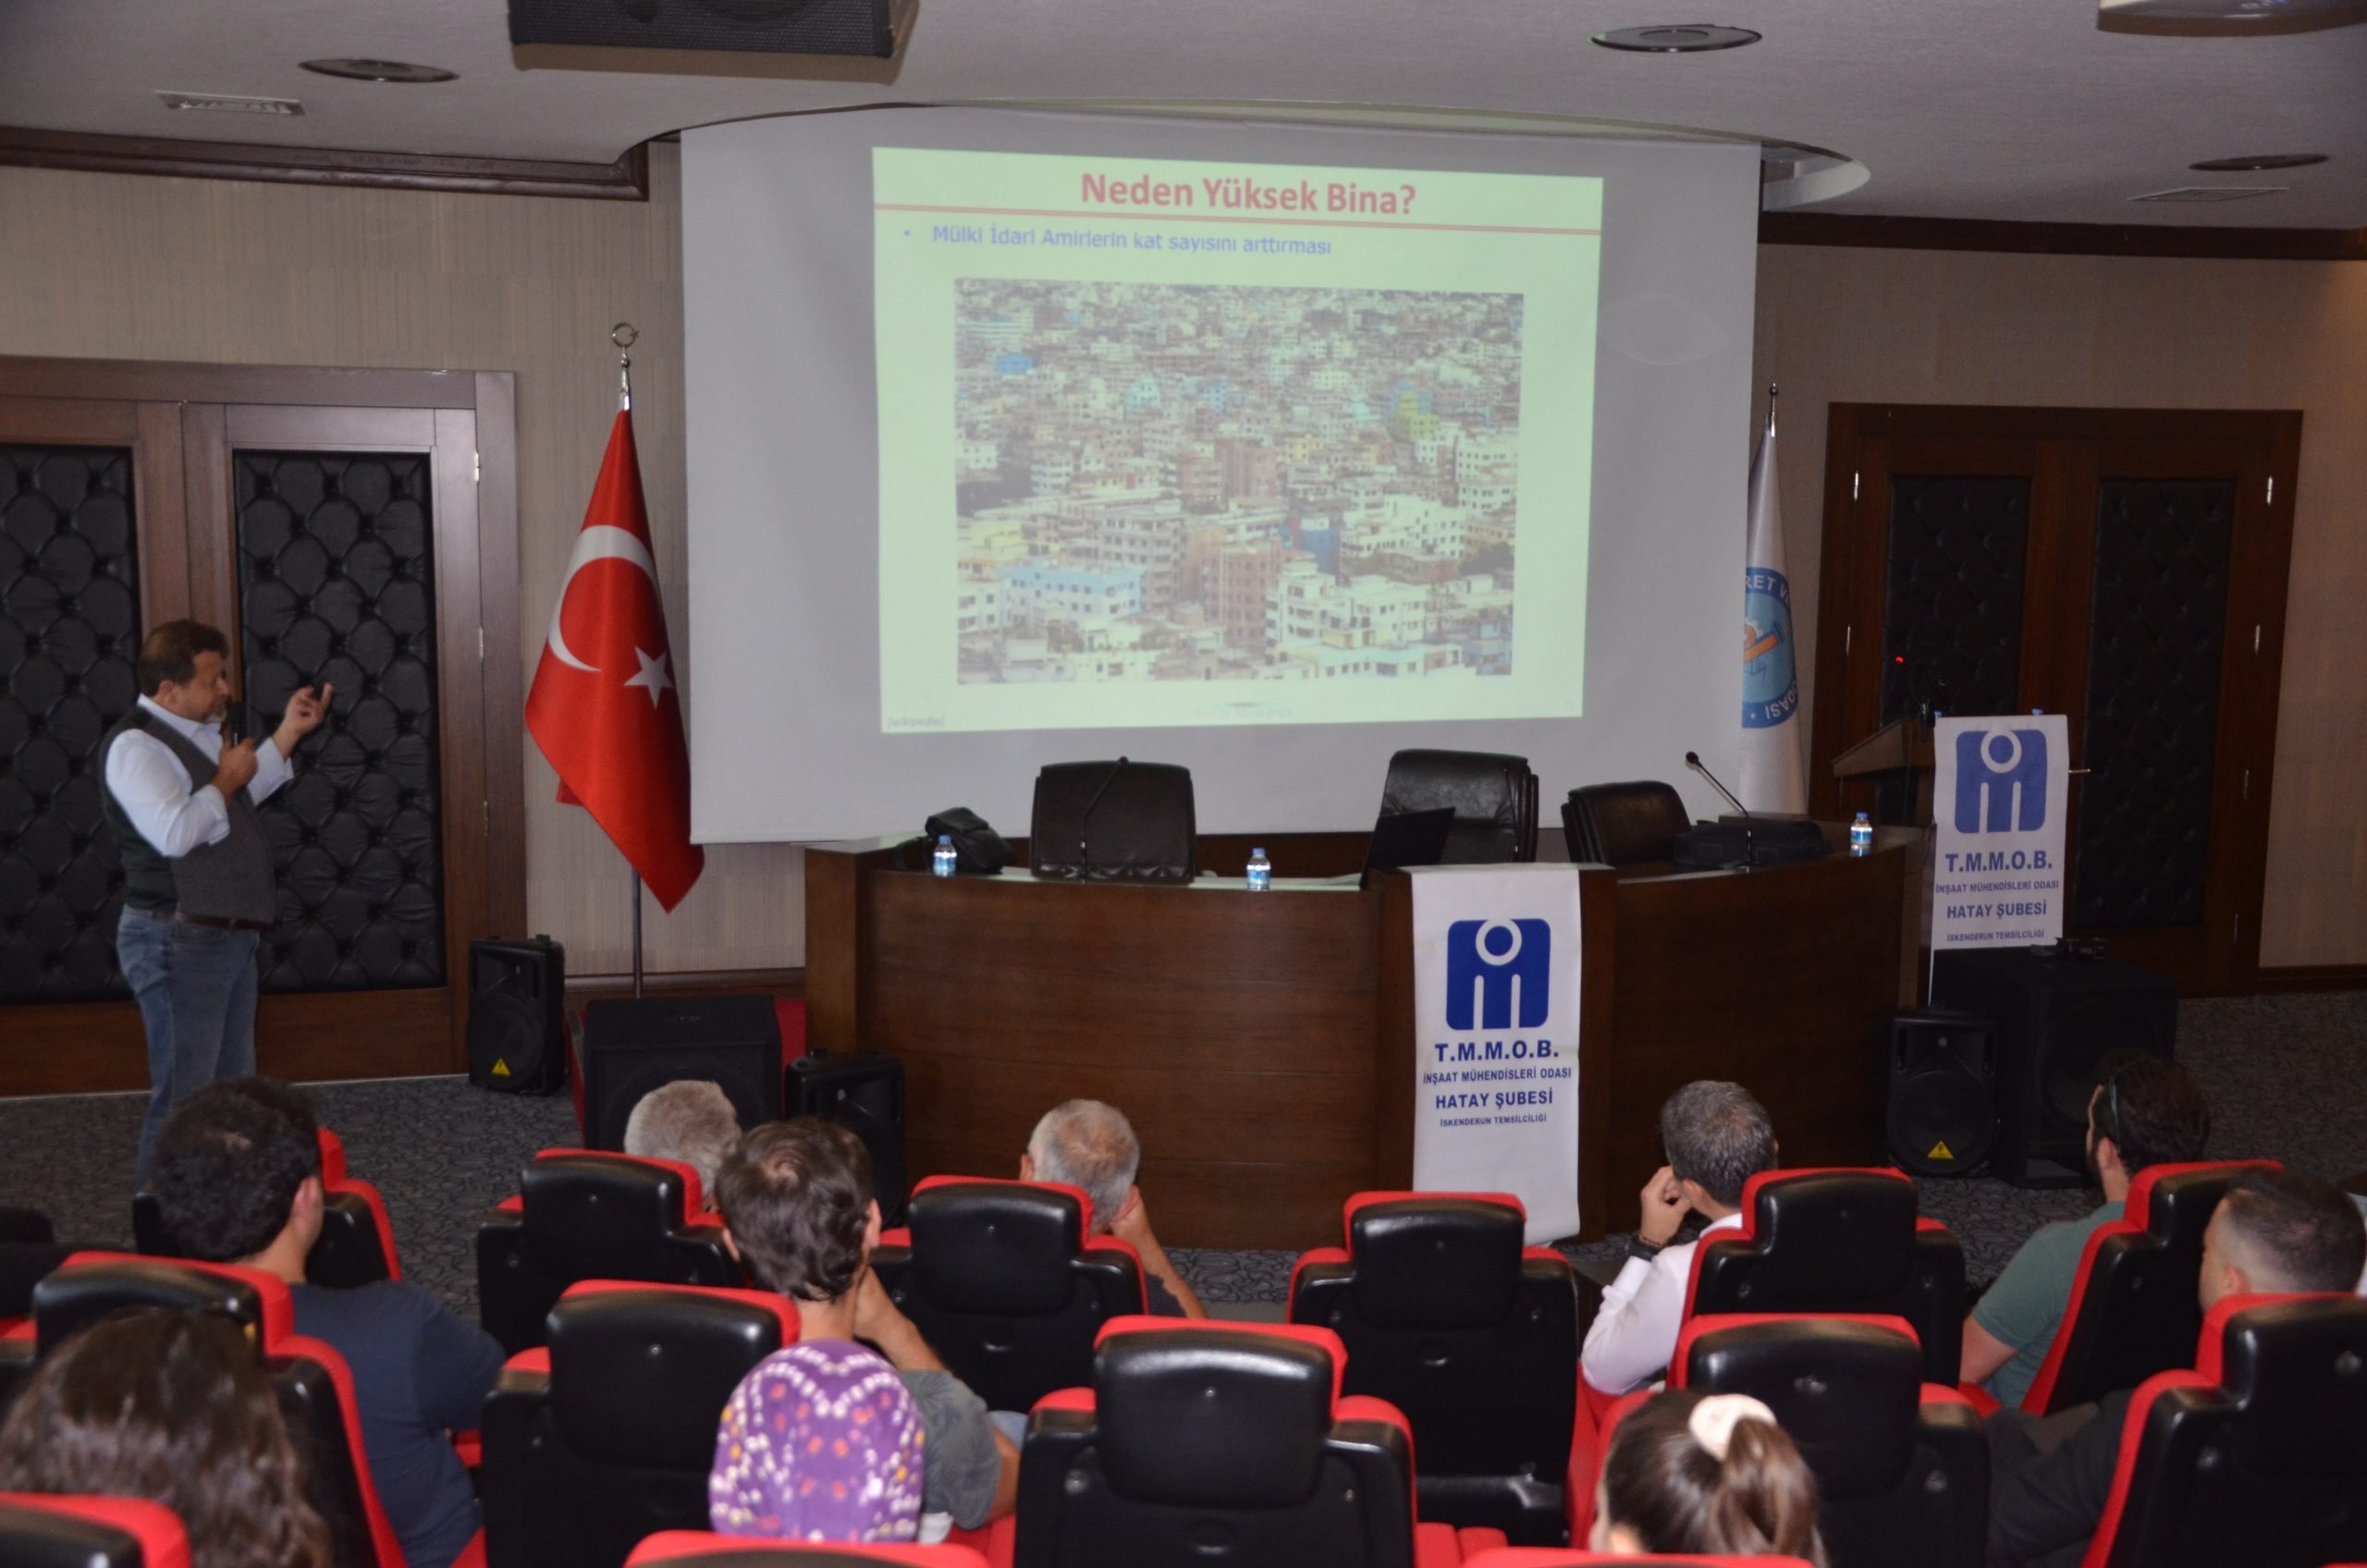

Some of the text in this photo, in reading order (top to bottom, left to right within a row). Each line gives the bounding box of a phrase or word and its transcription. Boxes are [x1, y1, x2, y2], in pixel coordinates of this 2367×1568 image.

[1081, 173, 1417, 215] Neden Yüksek Bina?
[932, 223, 1332, 255] Mülki İdari Amirlerin kat sayısını arttırması
[1944, 850, 2053, 873] T.M.M.O.B.
[1935, 879, 2059, 895] İNŞAAT MÜHENDİSLERİ ODASI
[1946, 899, 2047, 920] HATAY ŞUBESİ
[1946, 931, 1993, 942] İSKENDERUN
[1434, 1039, 1559, 1062] T.M.M.O.B.
[1423, 1065, 1572, 1085] İNŞAAT MÜHENDİSLERİ ODASI
[1435, 1087, 1553, 1110] HATAY ŞUBESİ
[1440, 1117, 1491, 1127] İSKENDERUN
